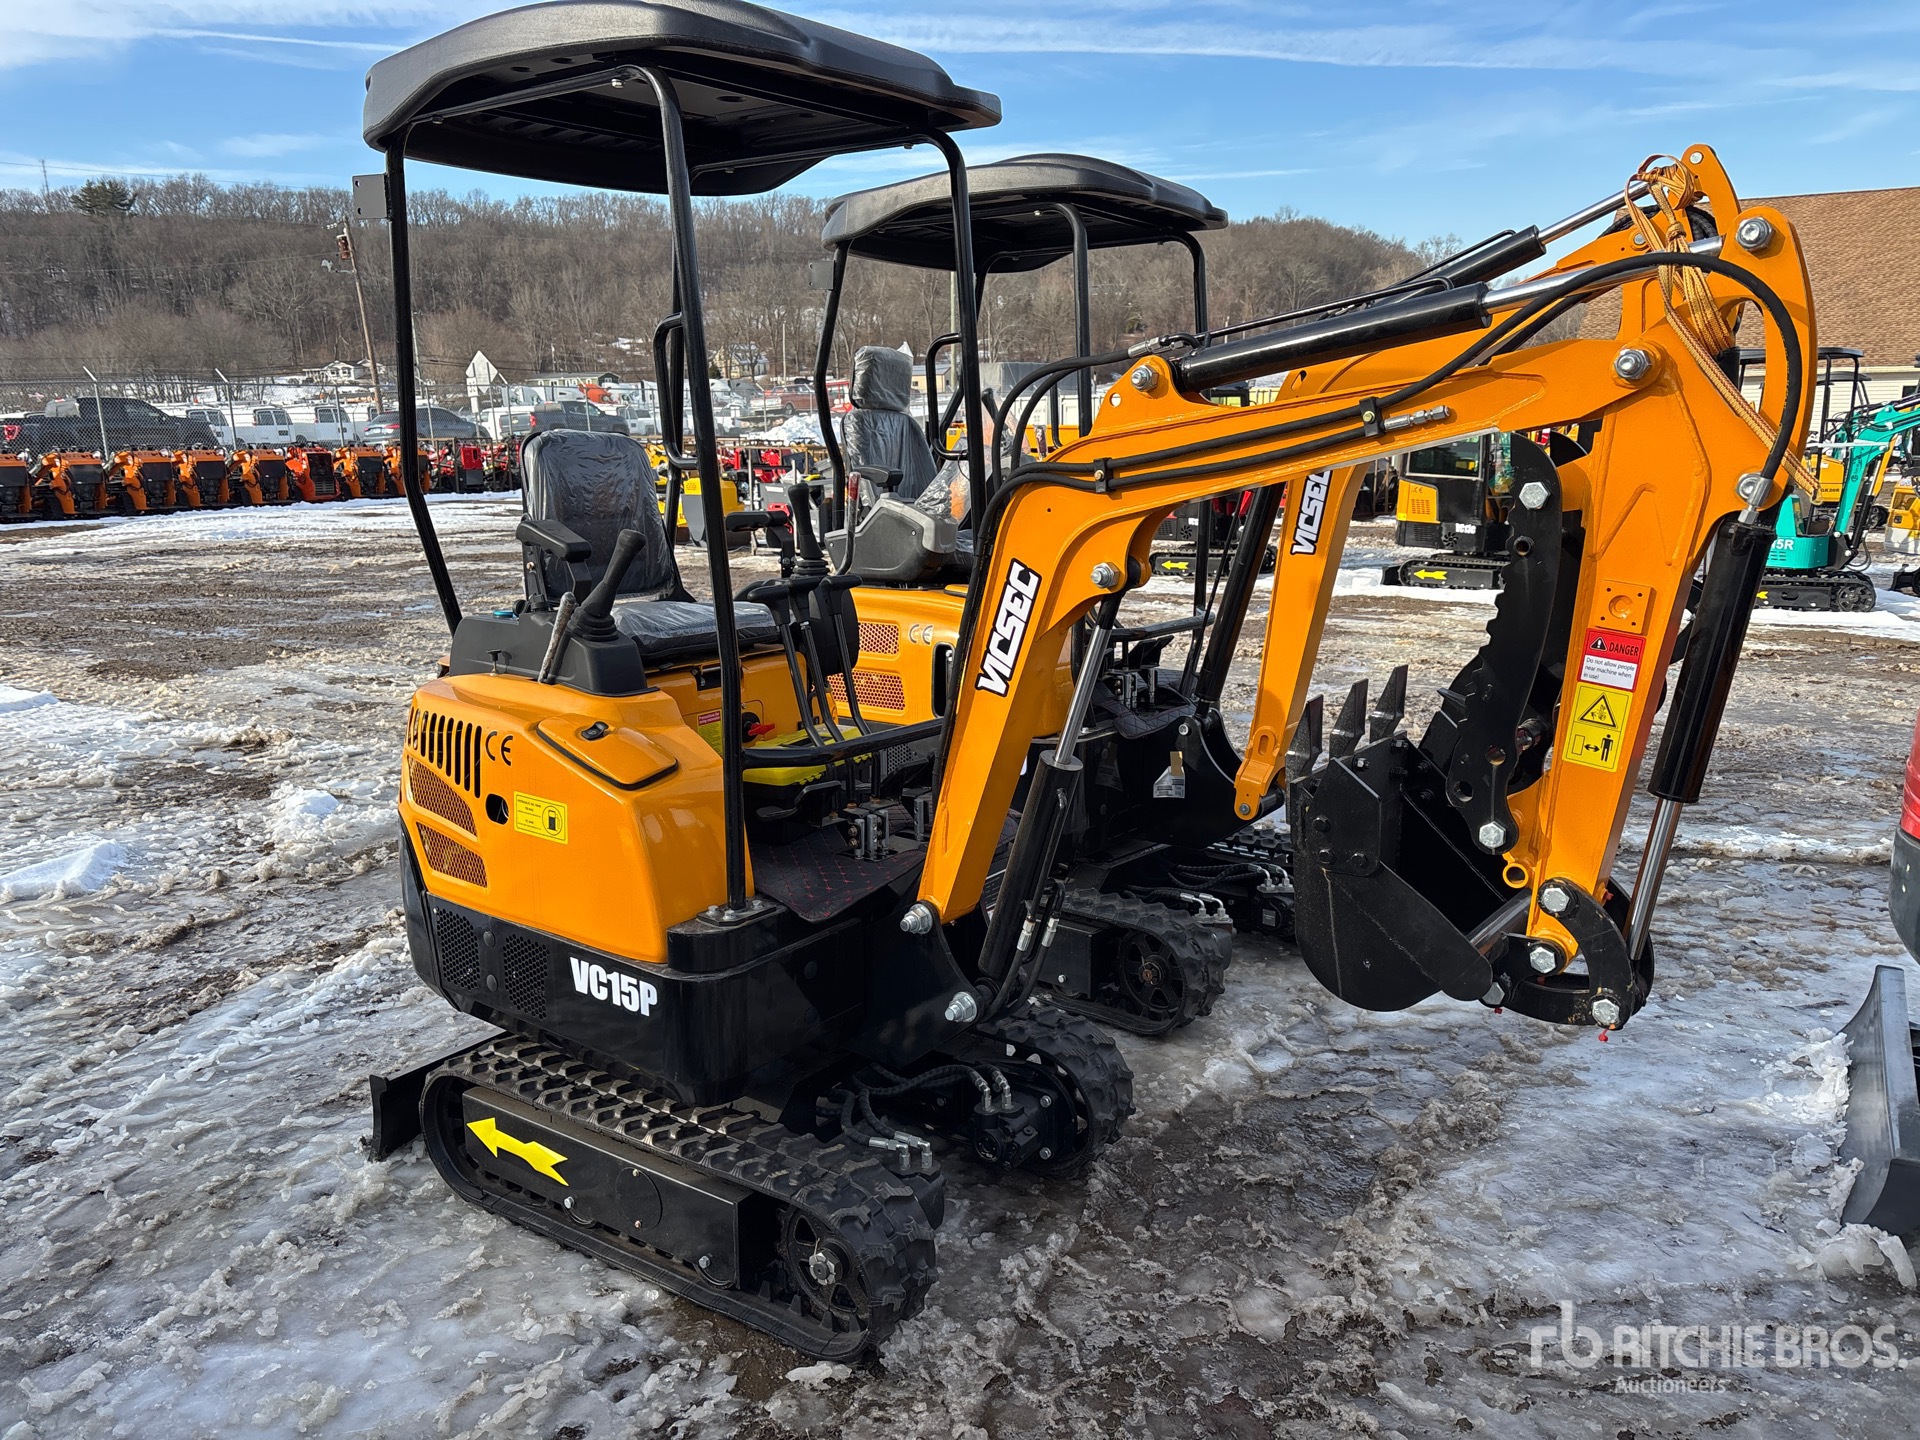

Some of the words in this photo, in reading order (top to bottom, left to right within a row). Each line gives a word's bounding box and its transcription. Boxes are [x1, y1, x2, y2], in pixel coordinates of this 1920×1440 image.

[909, 624, 934, 645] CE
[976, 560, 1040, 696] VICSEC
[1609, 642, 1640, 656] DANGER
[1596, 667, 1617, 676] machine
[1618, 670, 1632, 679] when
[1604, 660, 1617, 668] allow
[1617, 664, 1635, 672] people
[485, 730, 513, 767] CE
[569, 956, 658, 1017] VC15P
